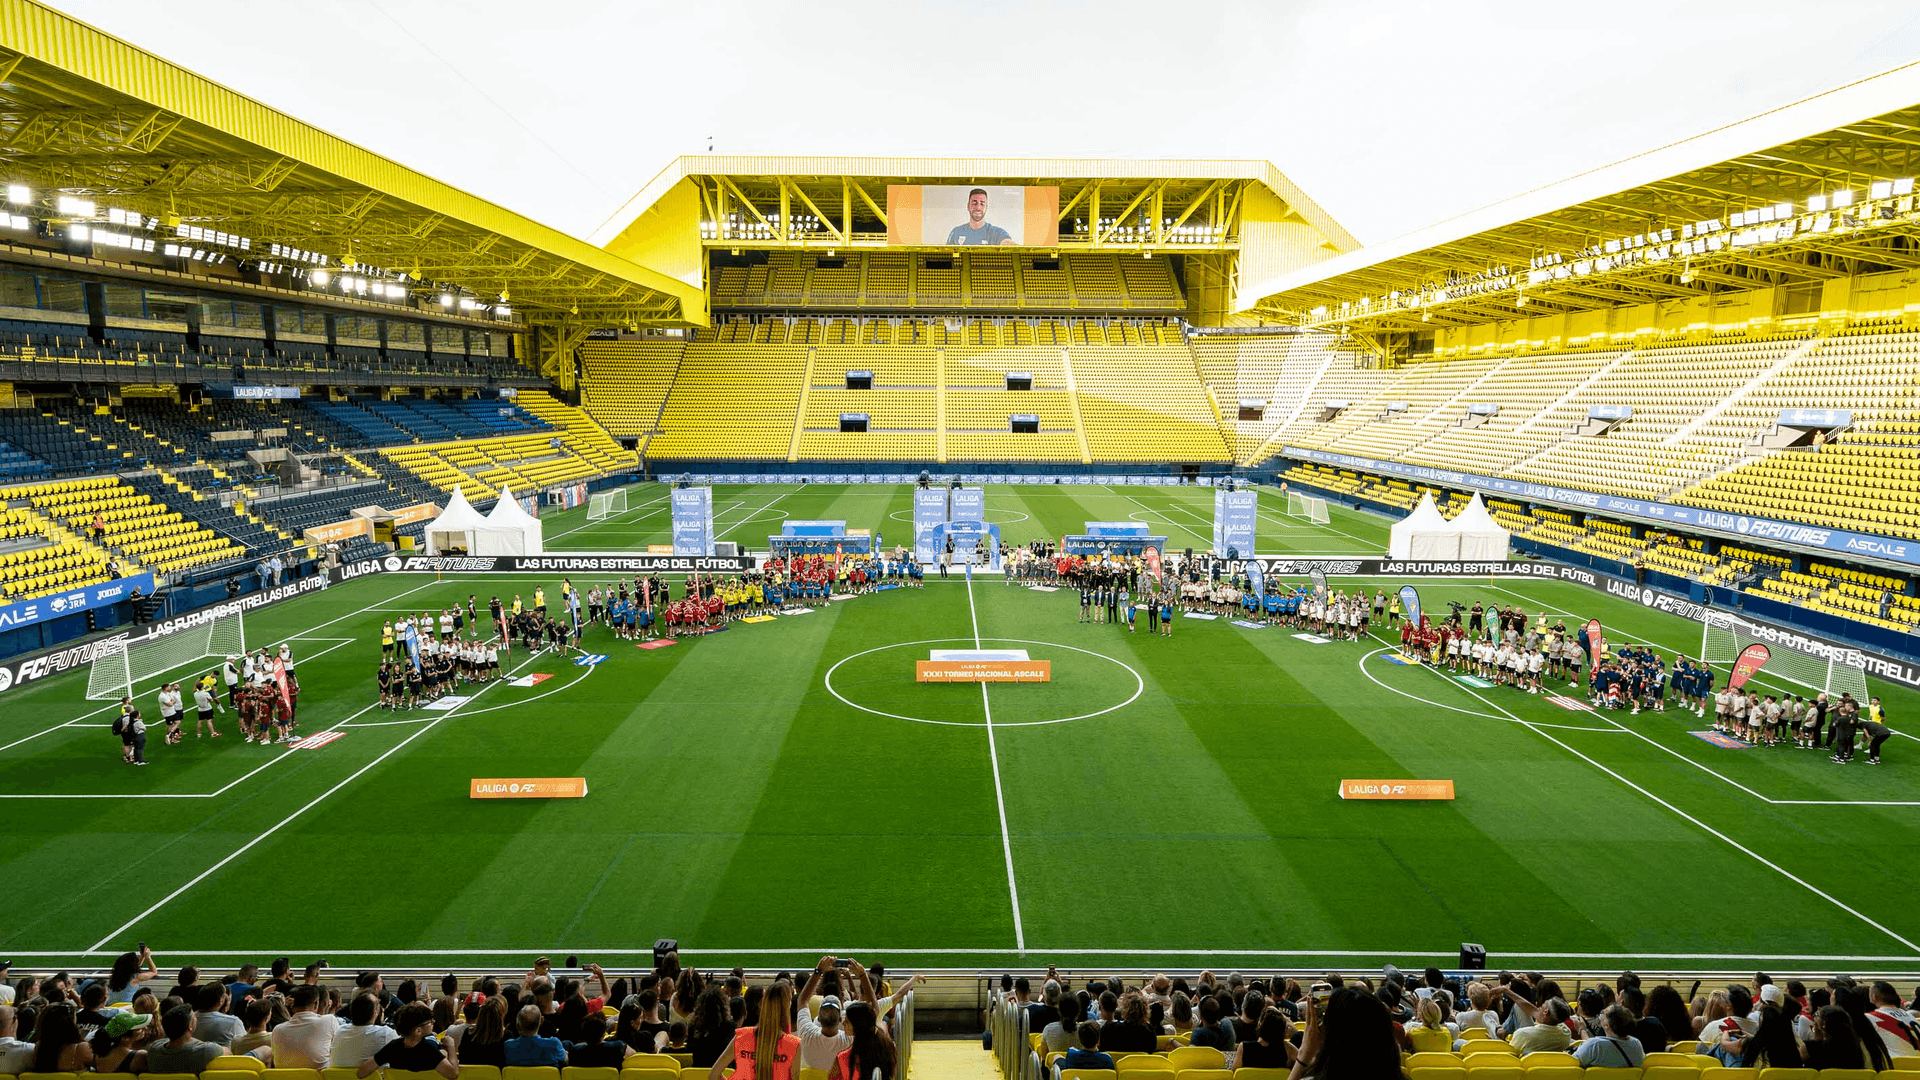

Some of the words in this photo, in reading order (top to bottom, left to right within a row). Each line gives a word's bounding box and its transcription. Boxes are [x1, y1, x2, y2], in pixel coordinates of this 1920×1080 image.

[1524, 485, 1546, 498] LALIGA
[1608, 500, 1640, 512] ASCALE
[1698, 512, 1735, 530] LALIGA
[1846, 537, 1907, 557] ASCALE
[341, 559, 381, 579] LALIGA
[515, 559, 540, 569] LAS
[541, 559, 598, 569] FUTURAS
[600, 559, 669, 569] ESTRELLAS
[671, 559, 696, 569] DEL
[696, 557, 743, 569] FÚTBOL
[1380, 563, 1403, 572] LAS
[1406, 563, 1461, 573] FUTURAS
[1463, 563, 1531, 575] ESTRELLAS
[1533, 565, 1558, 577] DEL
[1561, 567, 1596, 586] FÚTBOL
[1607, 579, 1640, 601] LALIGA
[69, 598, 86, 609] JRM
[148, 620, 173, 638] LAS
[175, 604, 228, 630] FUTURAS
[229, 589, 282, 615] ESTRELLAS
[283, 583, 299, 598] DEL
[1751, 623, 1777, 644] LAS
[1778, 631, 1844, 662] FUTURAS
[476, 784, 508, 792] LALIGA
[520, 784, 536, 792] FC
[1349, 785, 1379, 794] LALIGA
[1391, 785, 1406, 794] FC
[741, 1050, 788, 1062] STERD
